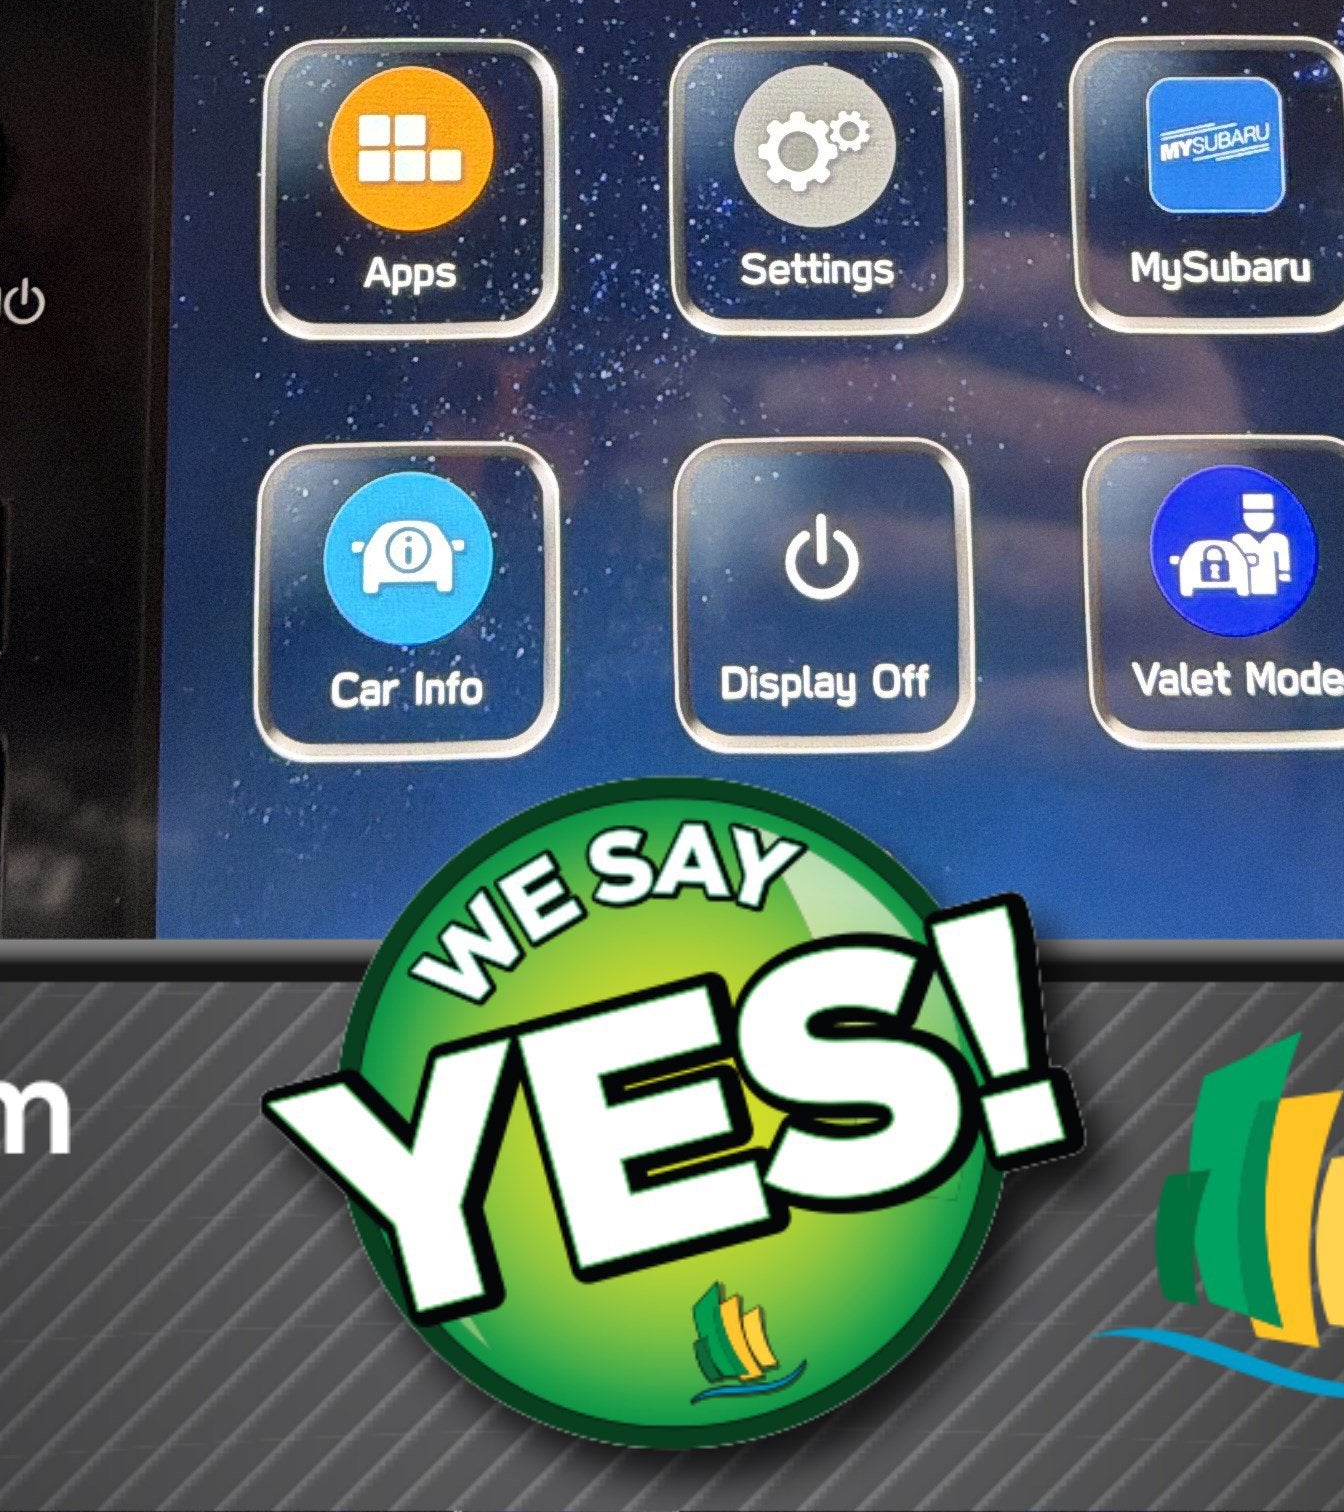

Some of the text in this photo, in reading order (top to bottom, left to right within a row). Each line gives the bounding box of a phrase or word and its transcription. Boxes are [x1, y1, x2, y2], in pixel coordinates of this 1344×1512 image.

[1159, 122, 1271, 163] MYSUBARU
[361, 255, 458, 297] Apps
[739, 251, 896, 294] Settings
[1129, 249, 1312, 292] MySubaru
[330, 669, 484, 710] Car Info
[720, 662, 931, 709] Display Off
[1130, 660, 1233, 698] Valet
